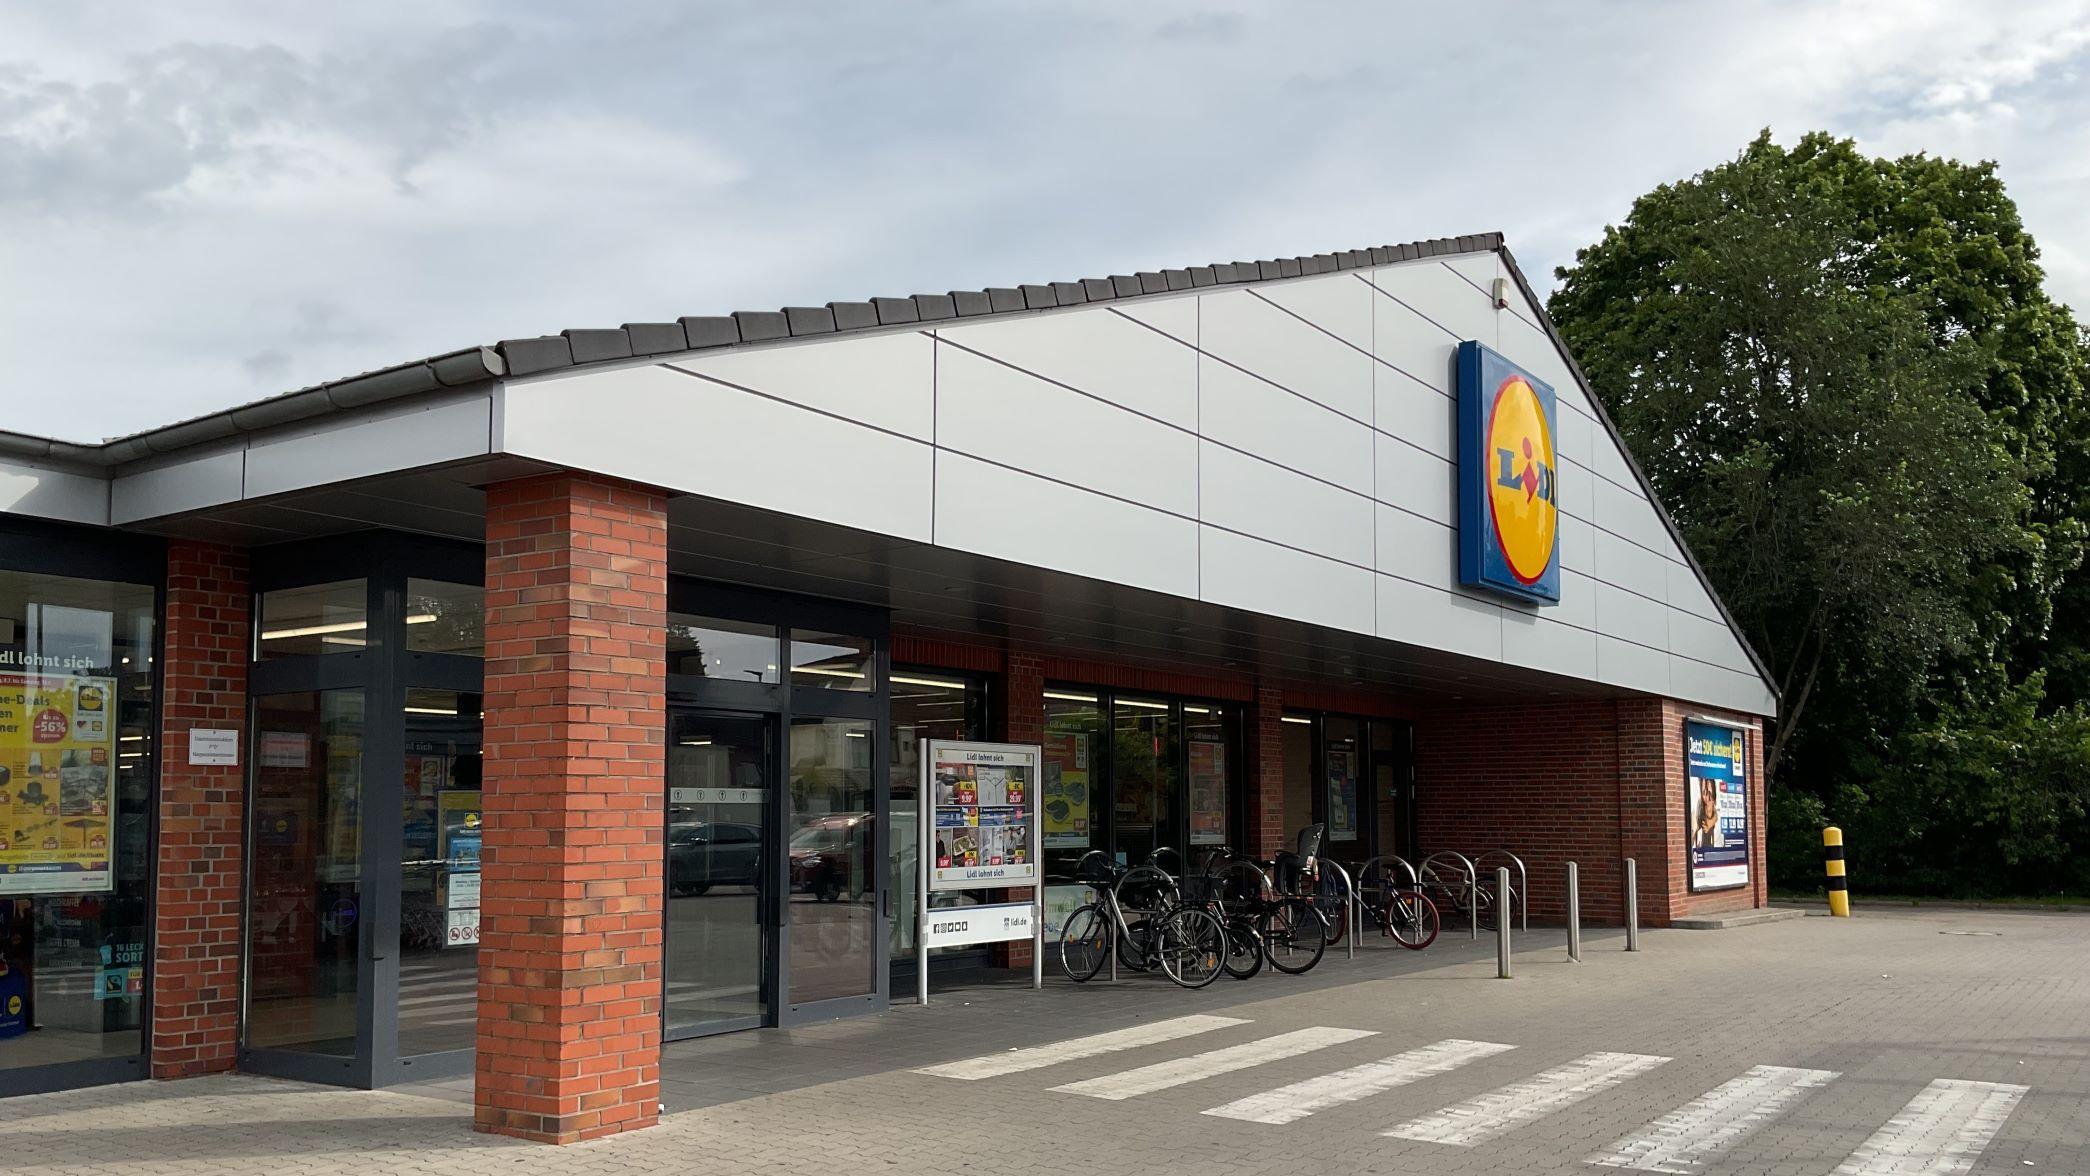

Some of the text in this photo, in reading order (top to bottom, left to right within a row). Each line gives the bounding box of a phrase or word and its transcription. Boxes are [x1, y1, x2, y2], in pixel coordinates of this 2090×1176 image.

[19, 652, 60, 666] lohnt
[63, 655, 94, 668] sich
[35, 721, 66, 733] -56%
[1690, 737, 1702, 754] Jetzt
[978, 754, 992, 762] lohnt
[1010, 917, 1026, 926] lidl.de
[116, 952, 143, 962] SORT
